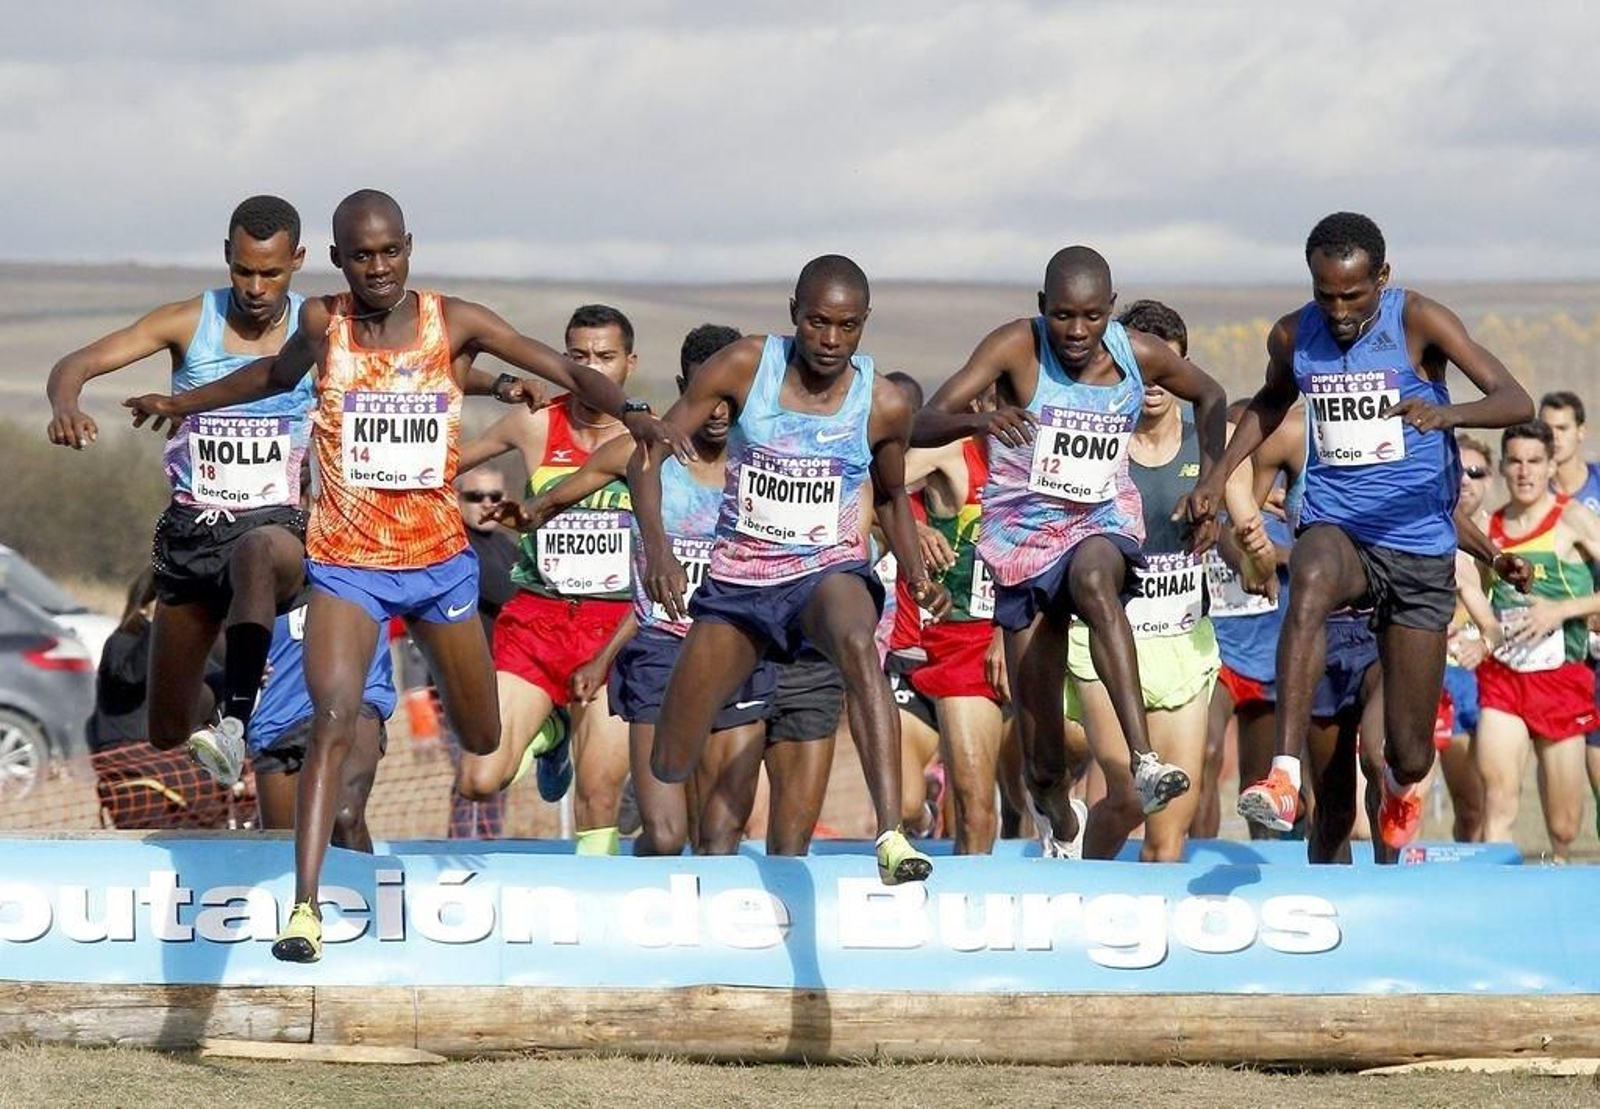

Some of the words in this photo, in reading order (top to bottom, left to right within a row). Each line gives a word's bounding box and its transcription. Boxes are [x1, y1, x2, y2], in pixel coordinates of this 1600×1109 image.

[1311, 371, 1385, 383] DIPUTACIÓN
[1312, 380, 1386, 393] BURGOS
[355, 402, 438, 414] BURGOS
[1311, 394, 1392, 422] MERGA
[199, 416, 279, 427] DIPUTACIÓN
[354, 417, 439, 444] KIPLIMO
[1051, 417, 1126, 433] BURGOS
[199, 426, 279, 437] BURGOS
[197, 438, 283, 465] MOLLA
[350, 446, 371, 463] 14
[1053, 431, 1120, 461] RONO
[199, 464, 216, 480] 18
[1041, 456, 1061, 475] 12
[350, 468, 407, 485] iberCaja
[197, 483, 250, 503] iberCaja
[747, 470, 835, 504] TOROITICH
[1036, 475, 1092, 498] iberCaja
[744, 497, 754, 513] 3
[743, 516, 797, 540] iberCaja
[544, 533, 623, 555] MERZOGUI
[543, 558, 560, 573] 57
[618, 873, 794, 950] de
[837, 877, 1342, 969] Burgos
